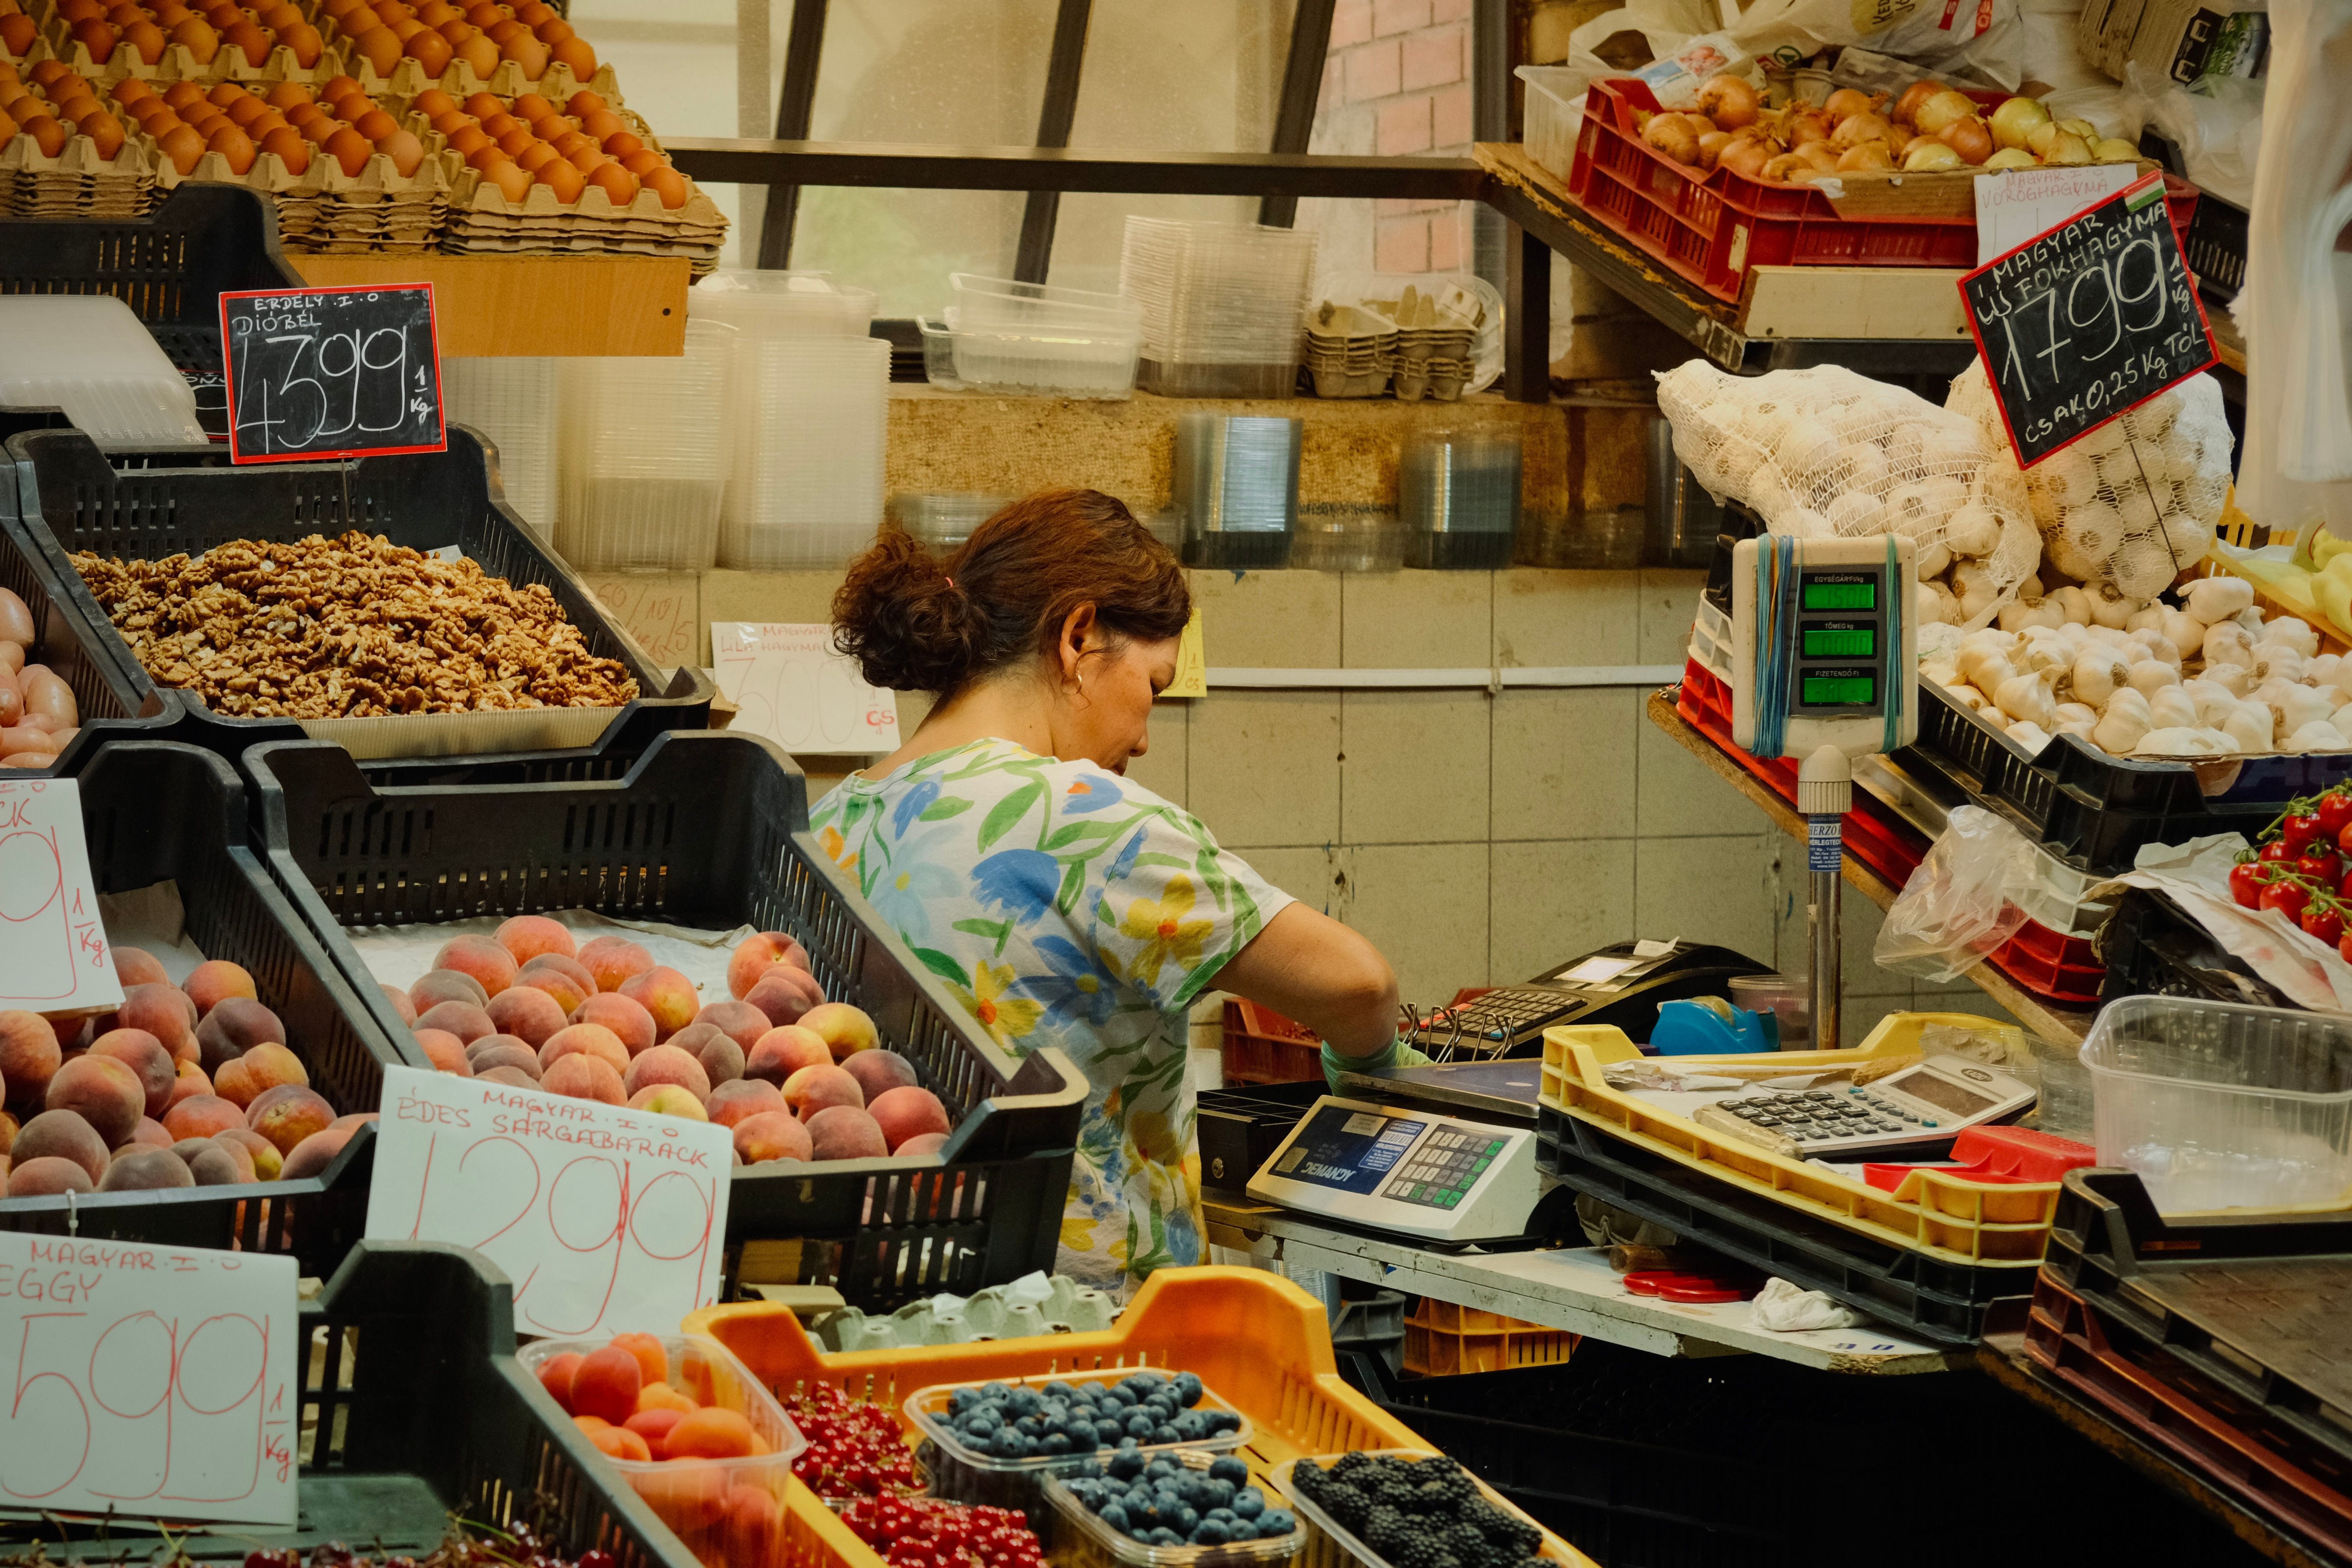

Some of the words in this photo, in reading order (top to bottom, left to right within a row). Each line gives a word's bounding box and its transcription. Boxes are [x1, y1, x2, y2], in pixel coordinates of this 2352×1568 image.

[1992, 214, 2103, 283] MAGYAR
[2015, 202, 2167, 300] FOKHAGYMA
[255, 293, 323, 311] ERDÉLY
[2003, 230, 2167, 401] 1799
[235, 325, 407, 454] 4399
[2025, 394, 2084, 443] CSAK
[1815, 573, 1848, 582] EGYSÉGÁR
[761, 642, 821, 653] HAGYMA
[763, 625, 825, 637] MAGYAR
[1815, 668, 1852, 677] FIZETENDŐ
[1964, 1068, 1988, 1081] KADIO
[482, 1090, 597, 1124] MAGYAR
[397, 1087, 472, 1128] ÉDES
[492, 1109, 709, 1169] SÁRGABARACK
[30, 1241, 156, 1270] MAGYAR
[1, 1310, 270, 1502] 599
